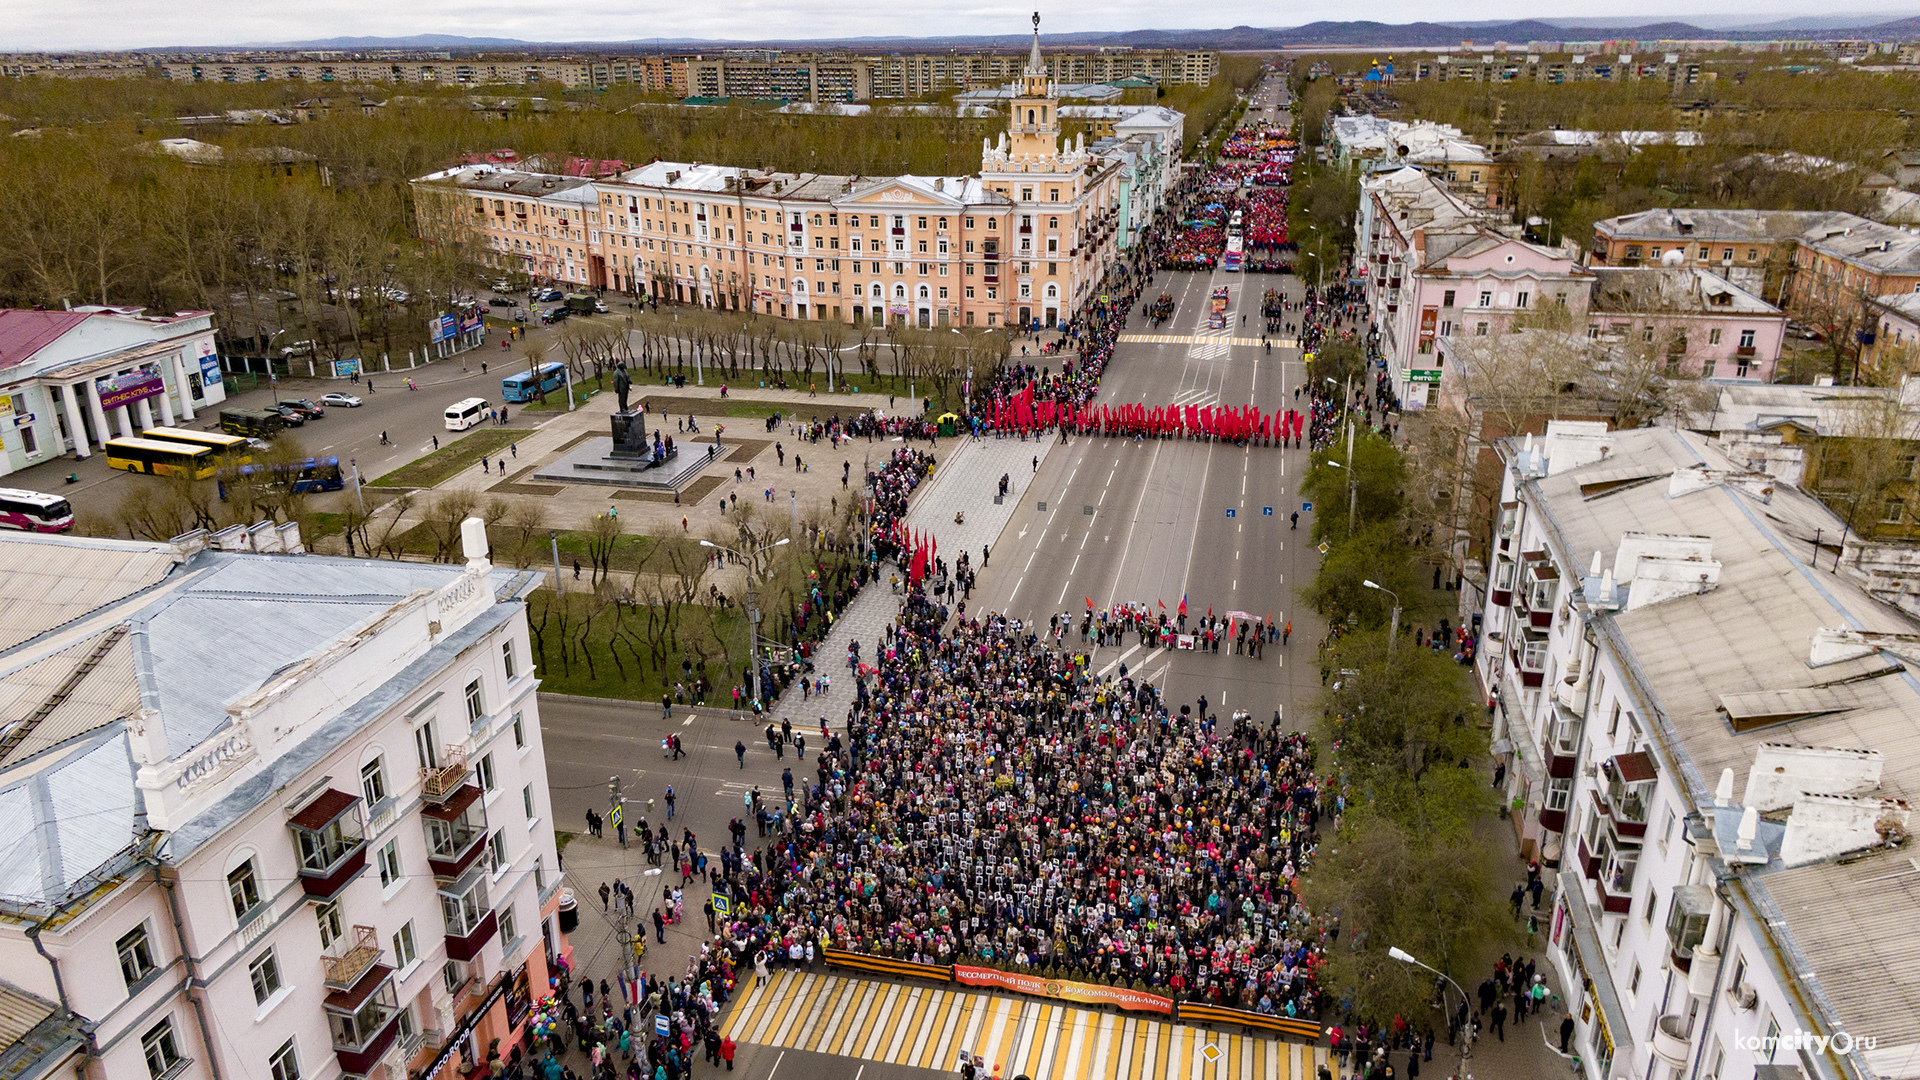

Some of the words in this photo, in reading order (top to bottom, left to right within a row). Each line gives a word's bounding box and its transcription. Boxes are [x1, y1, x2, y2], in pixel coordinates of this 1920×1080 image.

[957, 970, 1016, 985] БЕССМЕРТНЫЙ
[1017, 979, 1041, 989] ПОЛК
[1065, 985, 1171, 1009] КОМСОМОЛЬСК-НА-АМУРЕ
